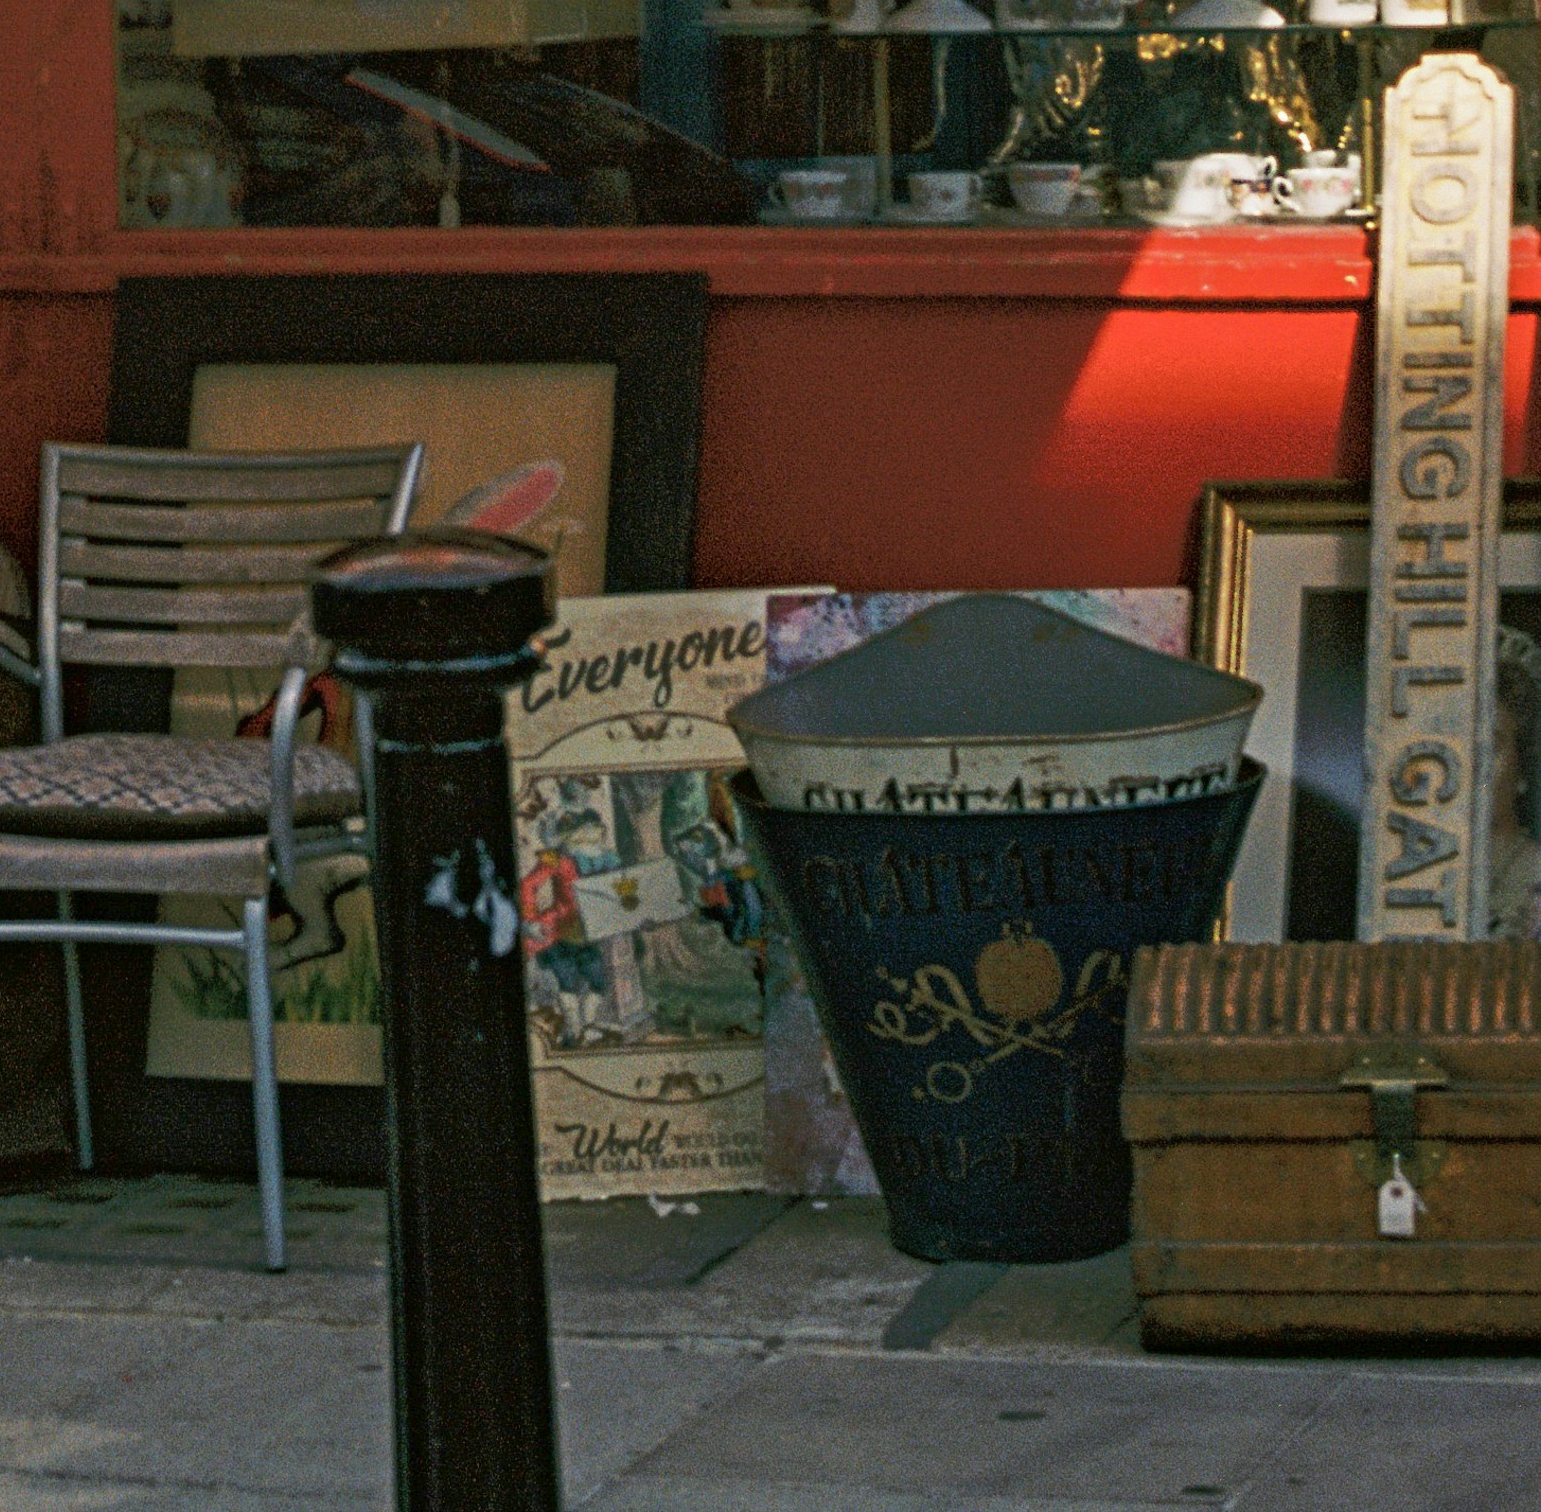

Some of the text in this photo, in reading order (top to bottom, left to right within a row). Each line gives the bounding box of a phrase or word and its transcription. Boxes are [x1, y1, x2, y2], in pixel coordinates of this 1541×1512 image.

[1383, 97, 1480, 943] NOTTING HILL GAT
[522, 619, 765, 713] Everyone
[554, 1119, 670, 1159] World
